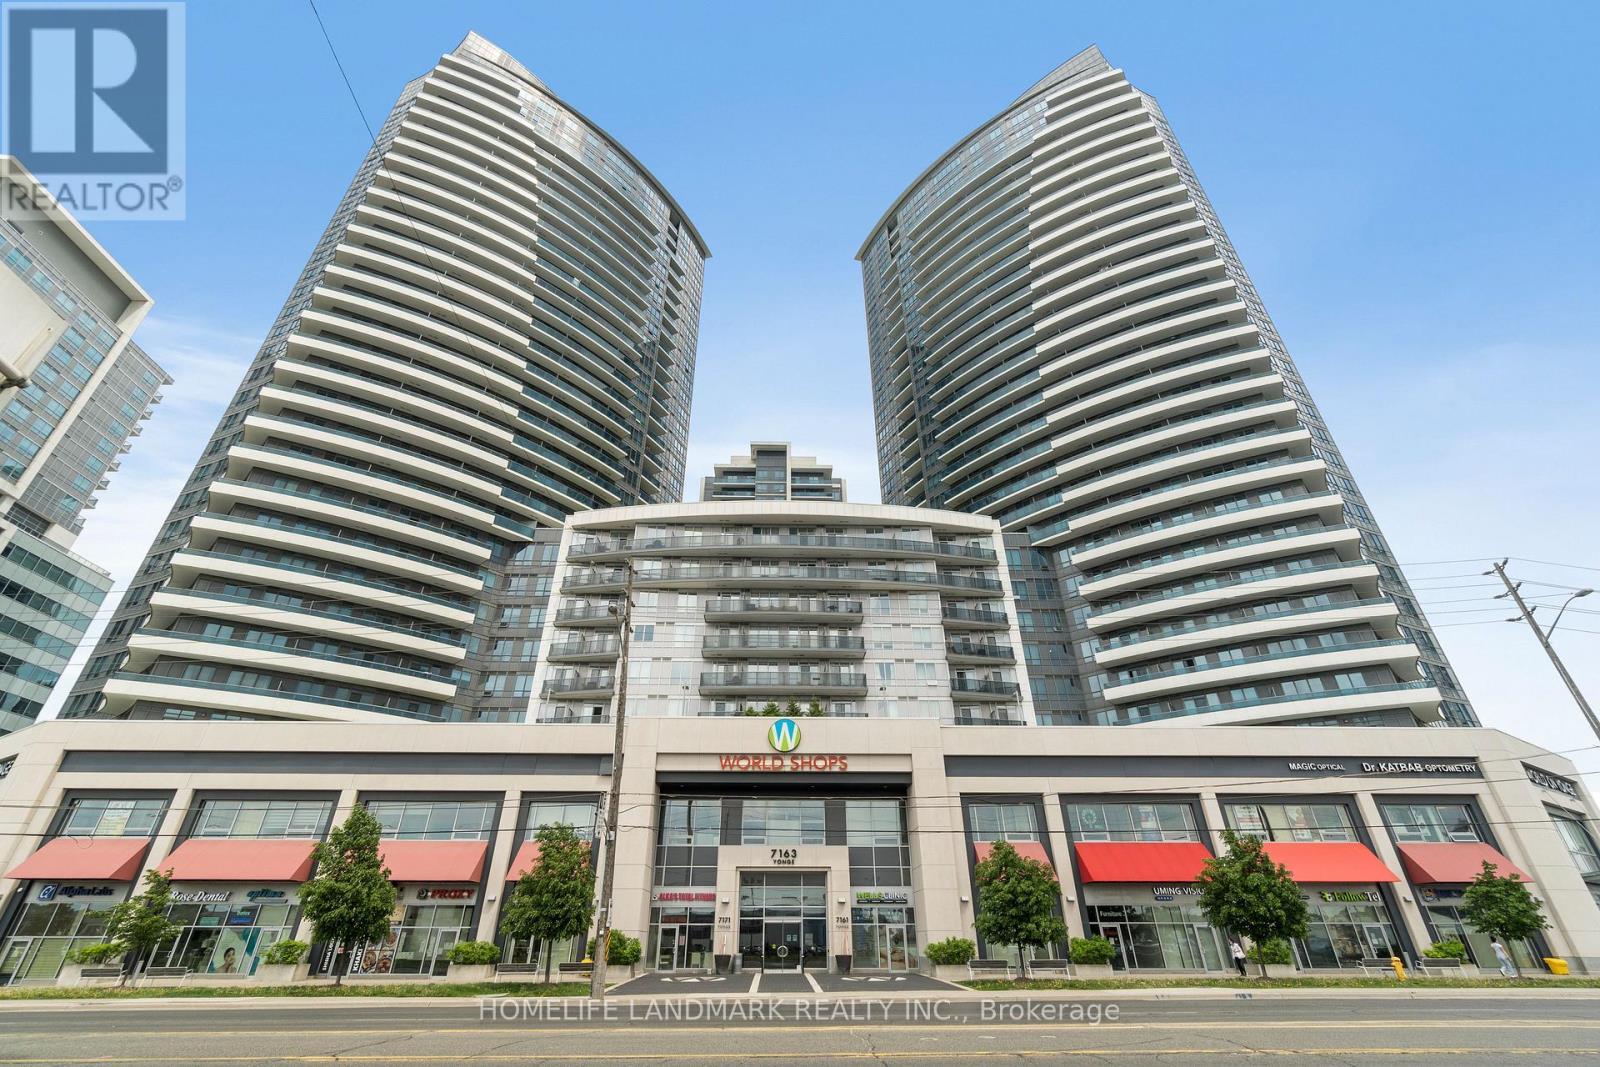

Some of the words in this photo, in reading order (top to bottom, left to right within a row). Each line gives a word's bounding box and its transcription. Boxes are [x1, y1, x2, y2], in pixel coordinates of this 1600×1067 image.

[719, 755, 784, 771] WORLD
[790, 755, 848, 771] SHOPS
[1288, 762, 1316, 771] MAGIC
[1379, 762, 1423, 772] KATBAB
[1425, 763, 1477, 773] OPTOMETRY
[770, 849, 797, 859] 7163
[718, 916, 731, 924] 7171
[835, 916, 849, 924] 7161
